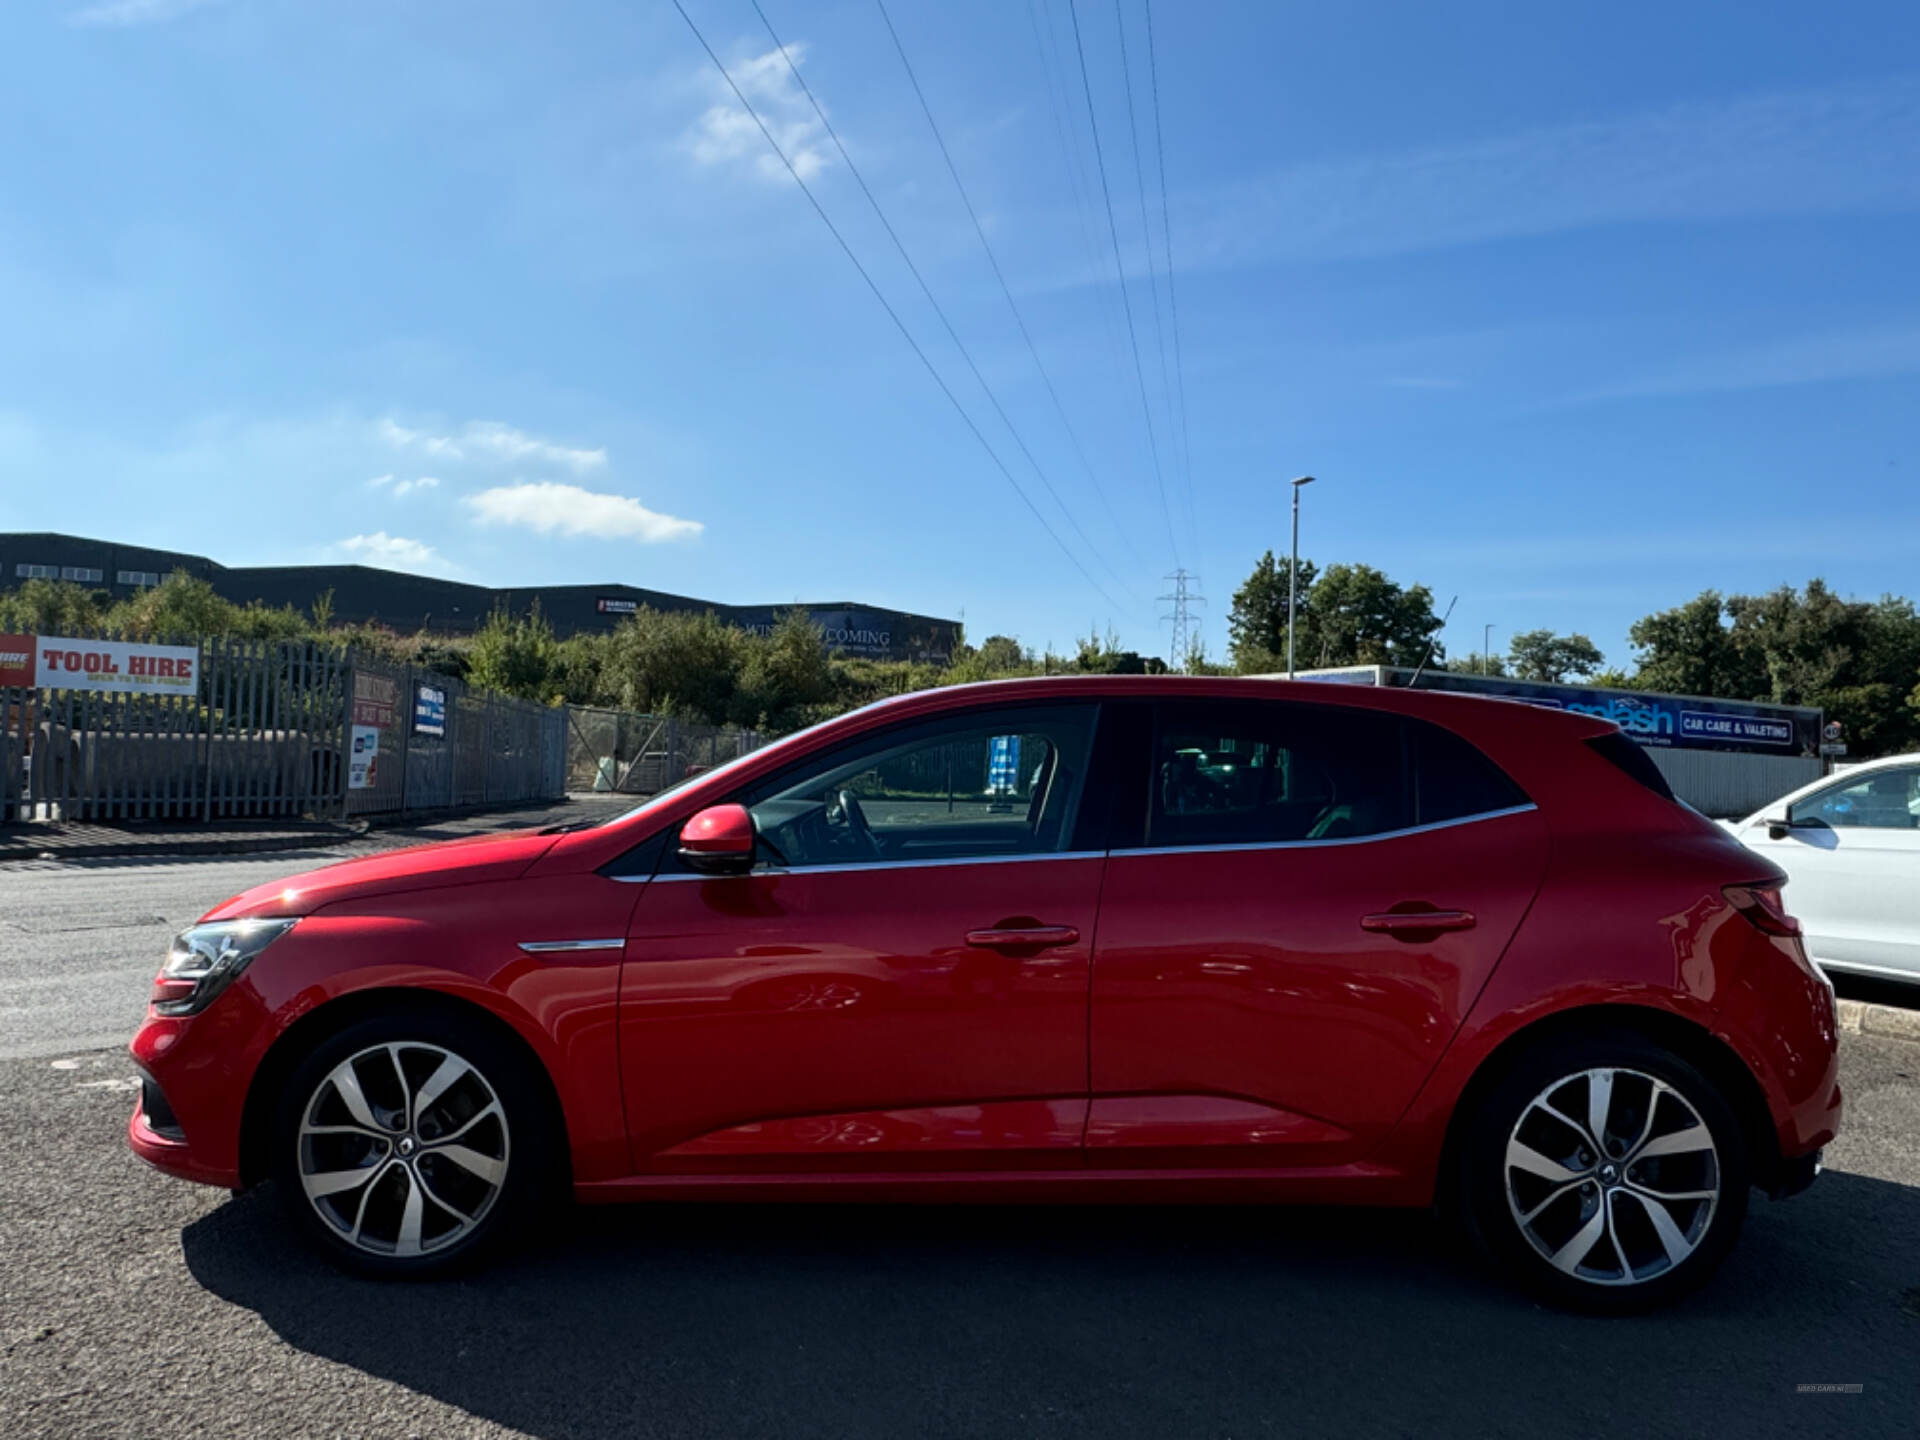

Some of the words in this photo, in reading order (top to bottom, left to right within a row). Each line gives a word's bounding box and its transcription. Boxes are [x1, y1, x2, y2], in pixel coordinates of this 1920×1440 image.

[825, 628, 890, 646] COMING
[43, 649, 118, 673] TOOL
[129, 655, 192, 678] HIRE
[1683, 718, 1703, 730] CAR
[1706, 721, 1732, 733] CARE
[1735, 723, 1741, 734] &
[1744, 724, 1788, 738] VALETING
